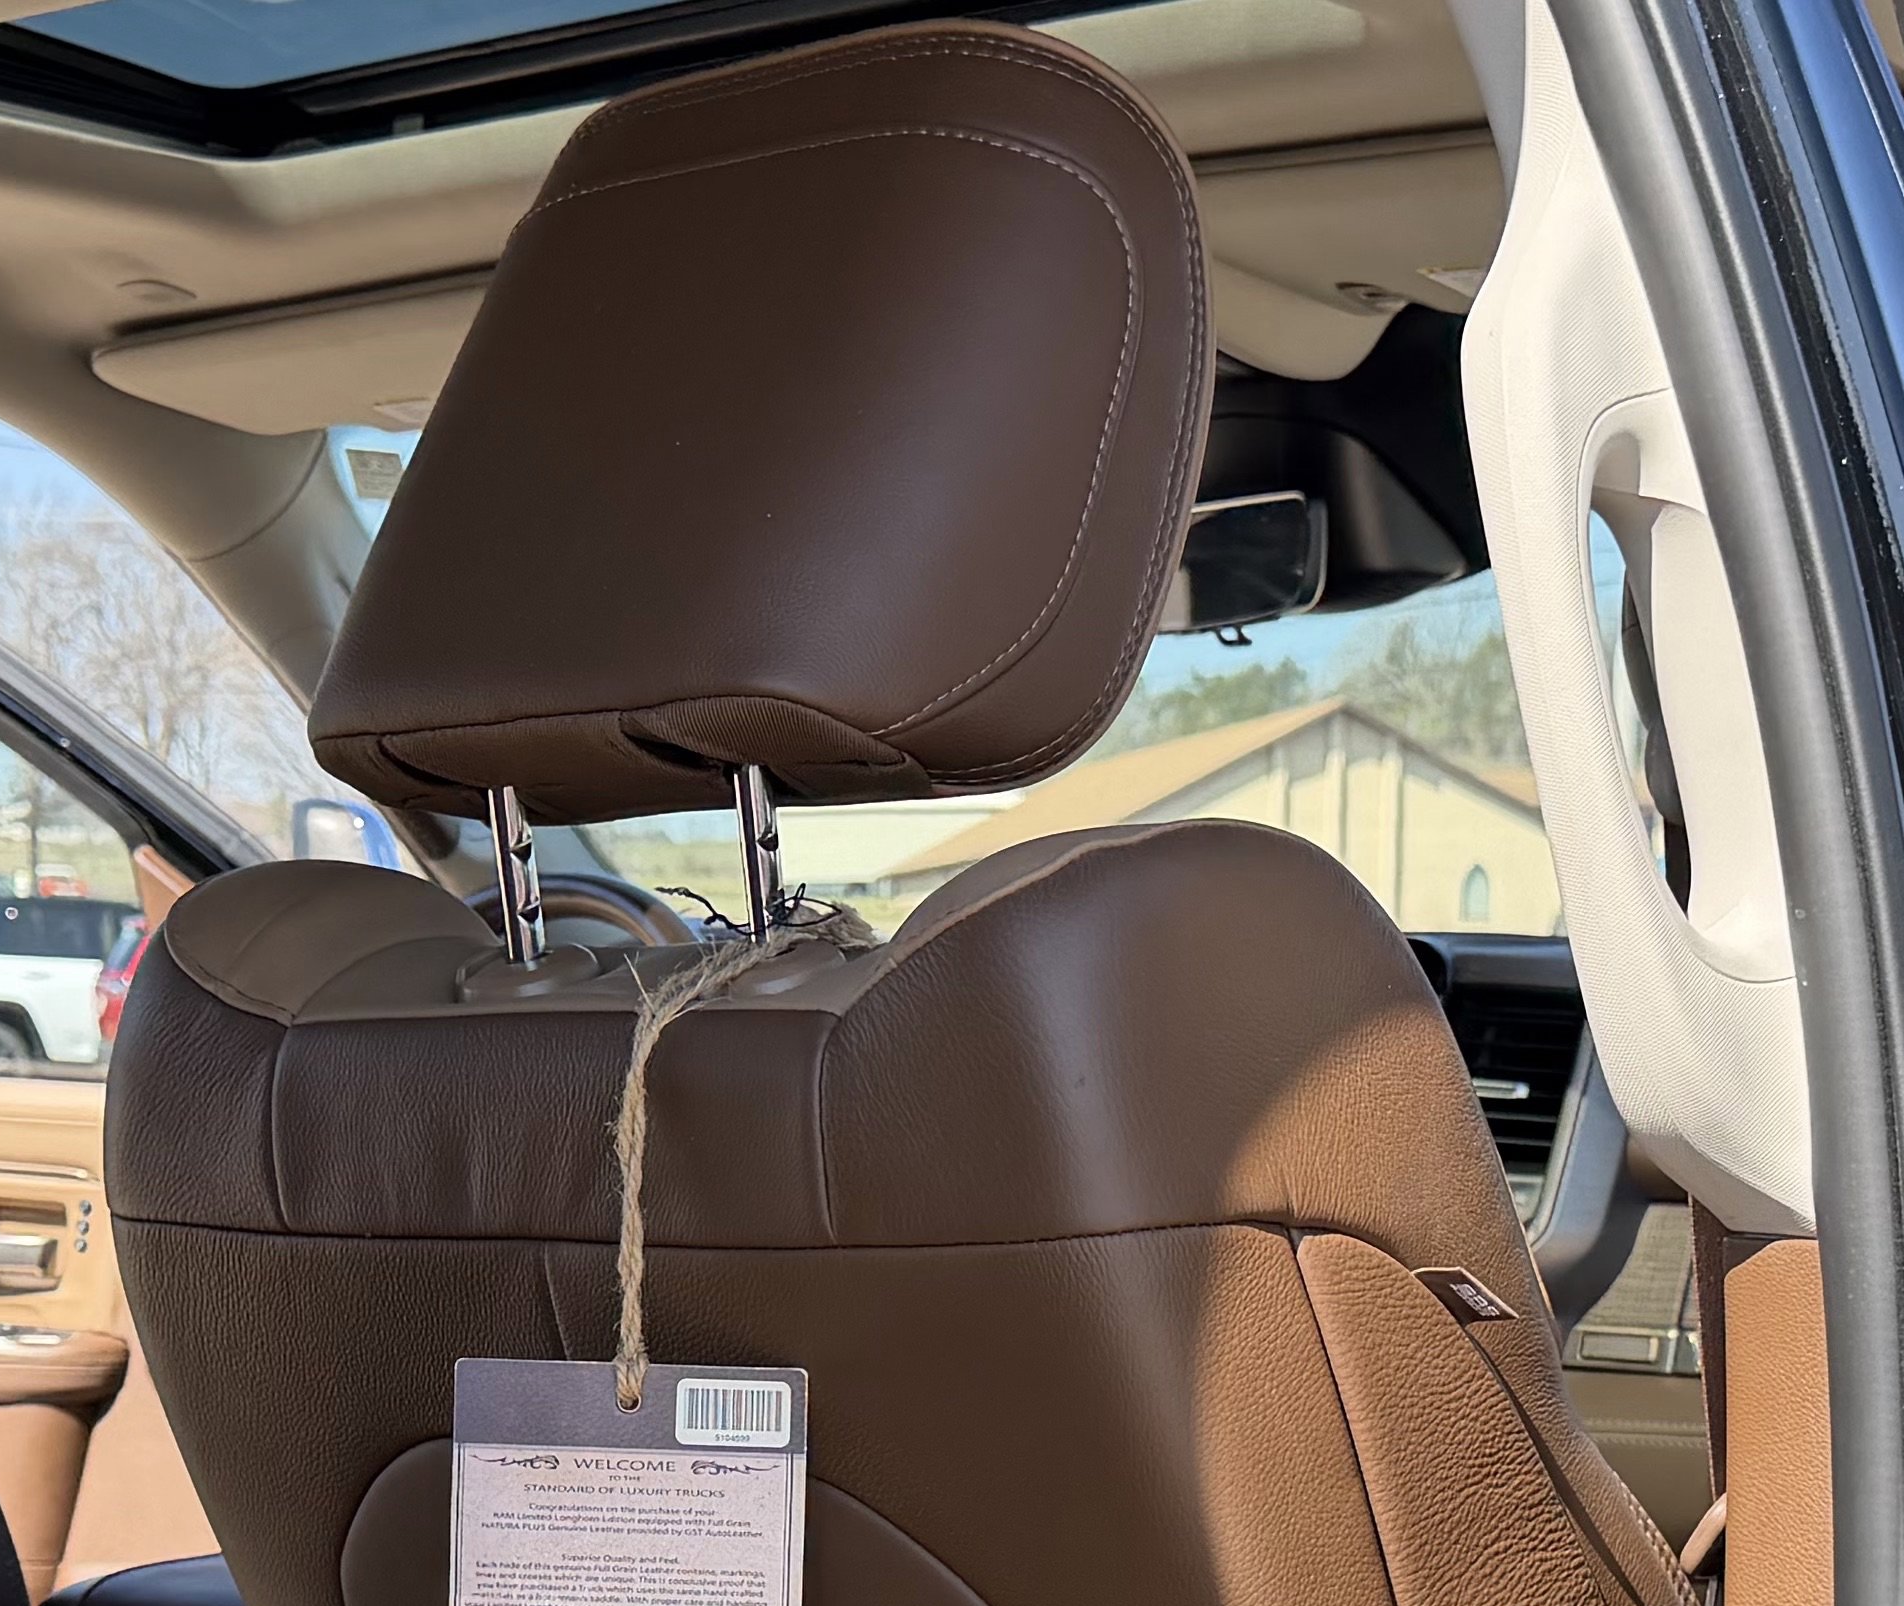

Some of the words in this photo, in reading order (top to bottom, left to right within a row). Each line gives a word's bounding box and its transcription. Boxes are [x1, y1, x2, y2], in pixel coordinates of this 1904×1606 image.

[573, 1457, 676, 1472] WELCOME
[523, 1483, 595, 1493] STANDARD
[597, 1485, 616, 1494] OF
[619, 1486, 671, 1496] LUXURY
[675, 1488, 725, 1498] TRUCKS
[528, 1502, 604, 1514] Congratulations
[620, 1505, 636, 1513] the
[637, 1506, 680, 1516] purchase
[516, 1511, 553, 1520] Limited
[554, 1513, 600, 1524] Longhorn
[636, 1515, 682, 1526] equipped
[684, 1517, 705, 1525] with
[725, 1519, 751, 1527] Grain
[547, 1523, 587, 1532] Genuine
[589, 1524, 624, 1533] Leather
[626, 1526, 669, 1536] provided
[560, 1553, 601, 1564] Superior
[602, 1554, 636, 1565] Quality
[638, 1556, 657, 1564] and
[638, 1566, 675, 1574] Leather
